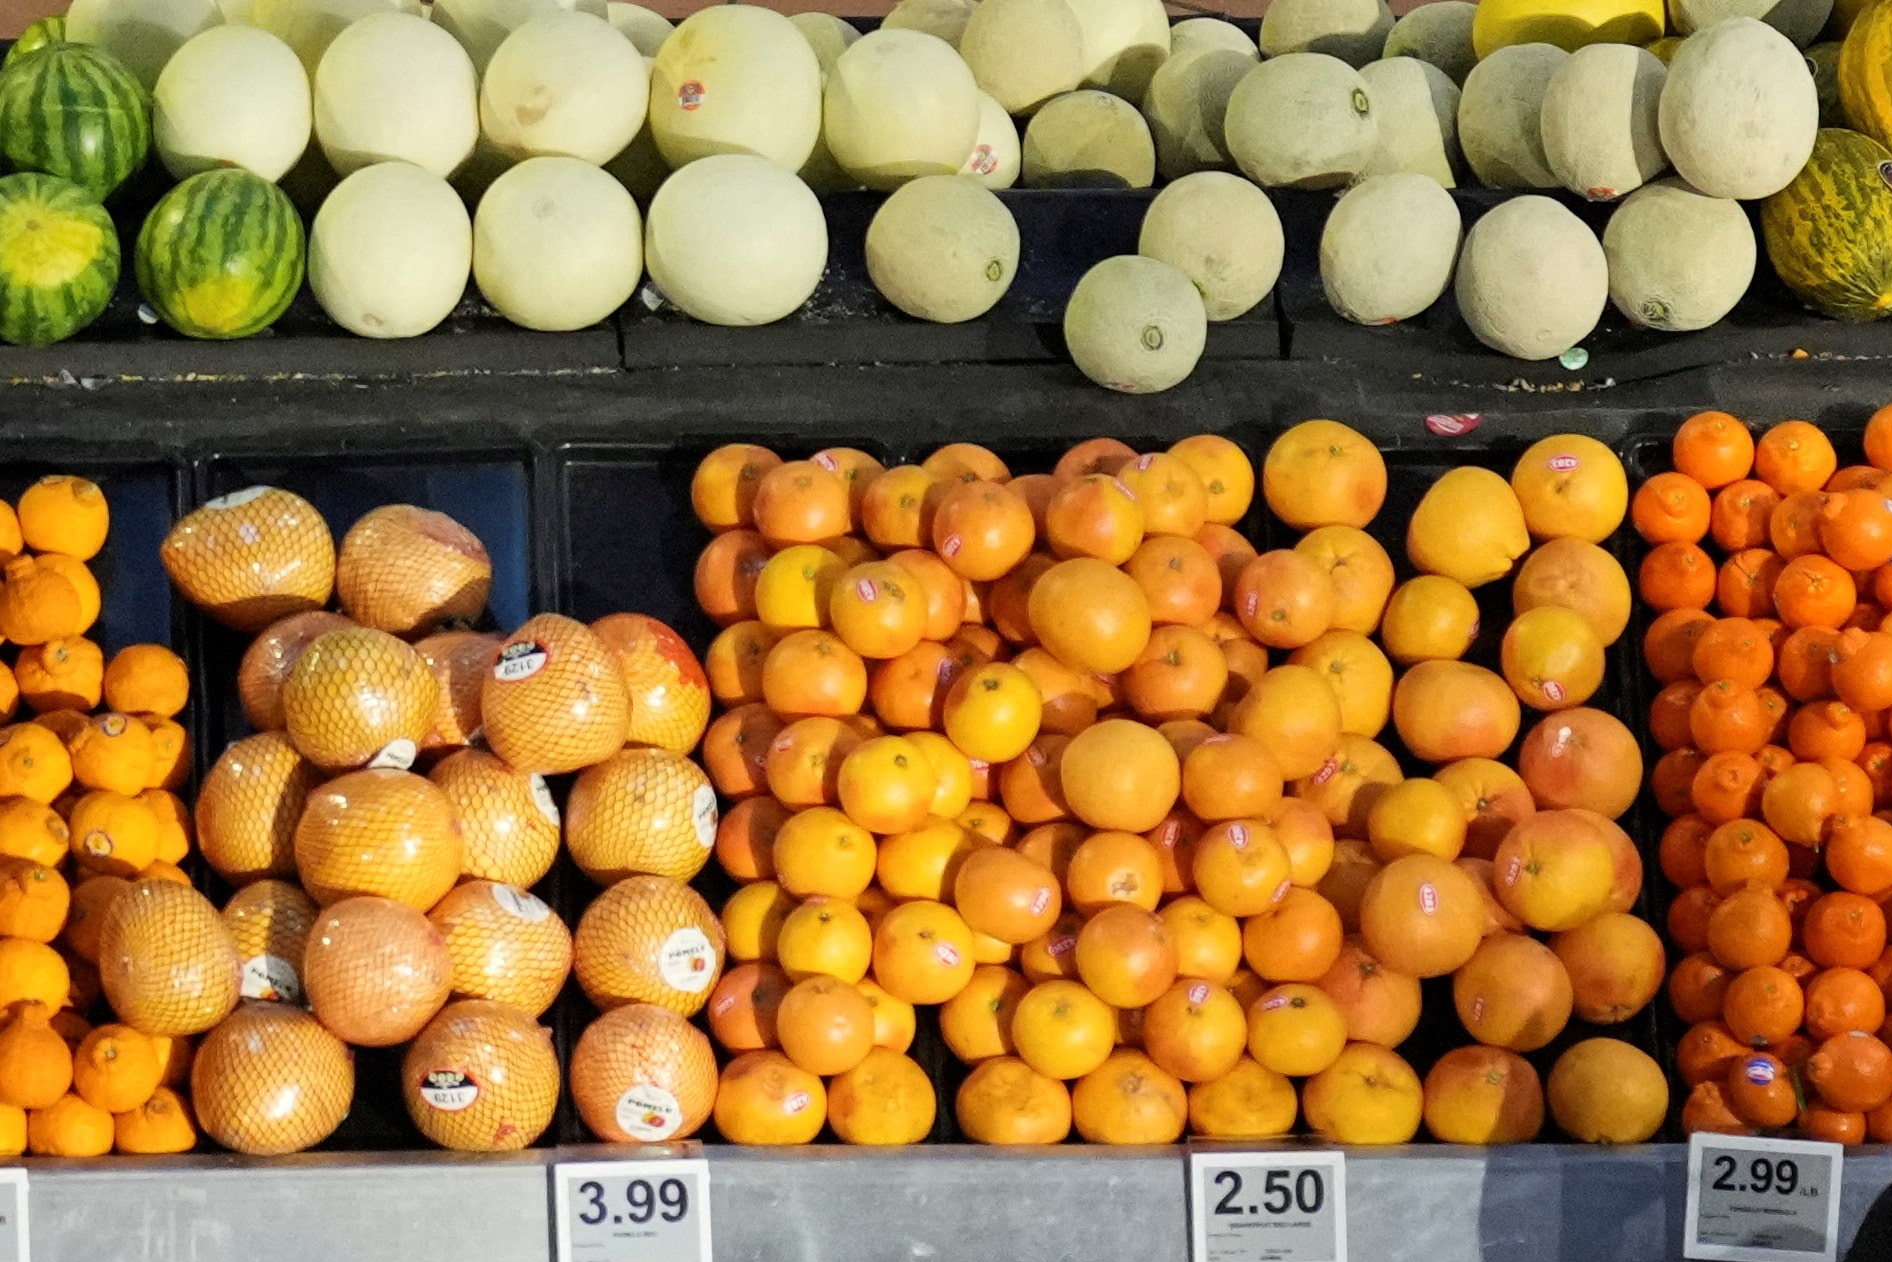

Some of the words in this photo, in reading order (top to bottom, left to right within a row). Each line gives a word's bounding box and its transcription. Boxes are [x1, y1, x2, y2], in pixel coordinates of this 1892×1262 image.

[434, 1091, 465, 1104] 3129
[1214, 1169, 1325, 1215] 2.50
[1712, 1155, 1799, 1195] 2.99
[578, 1178, 689, 1225] 3.99
